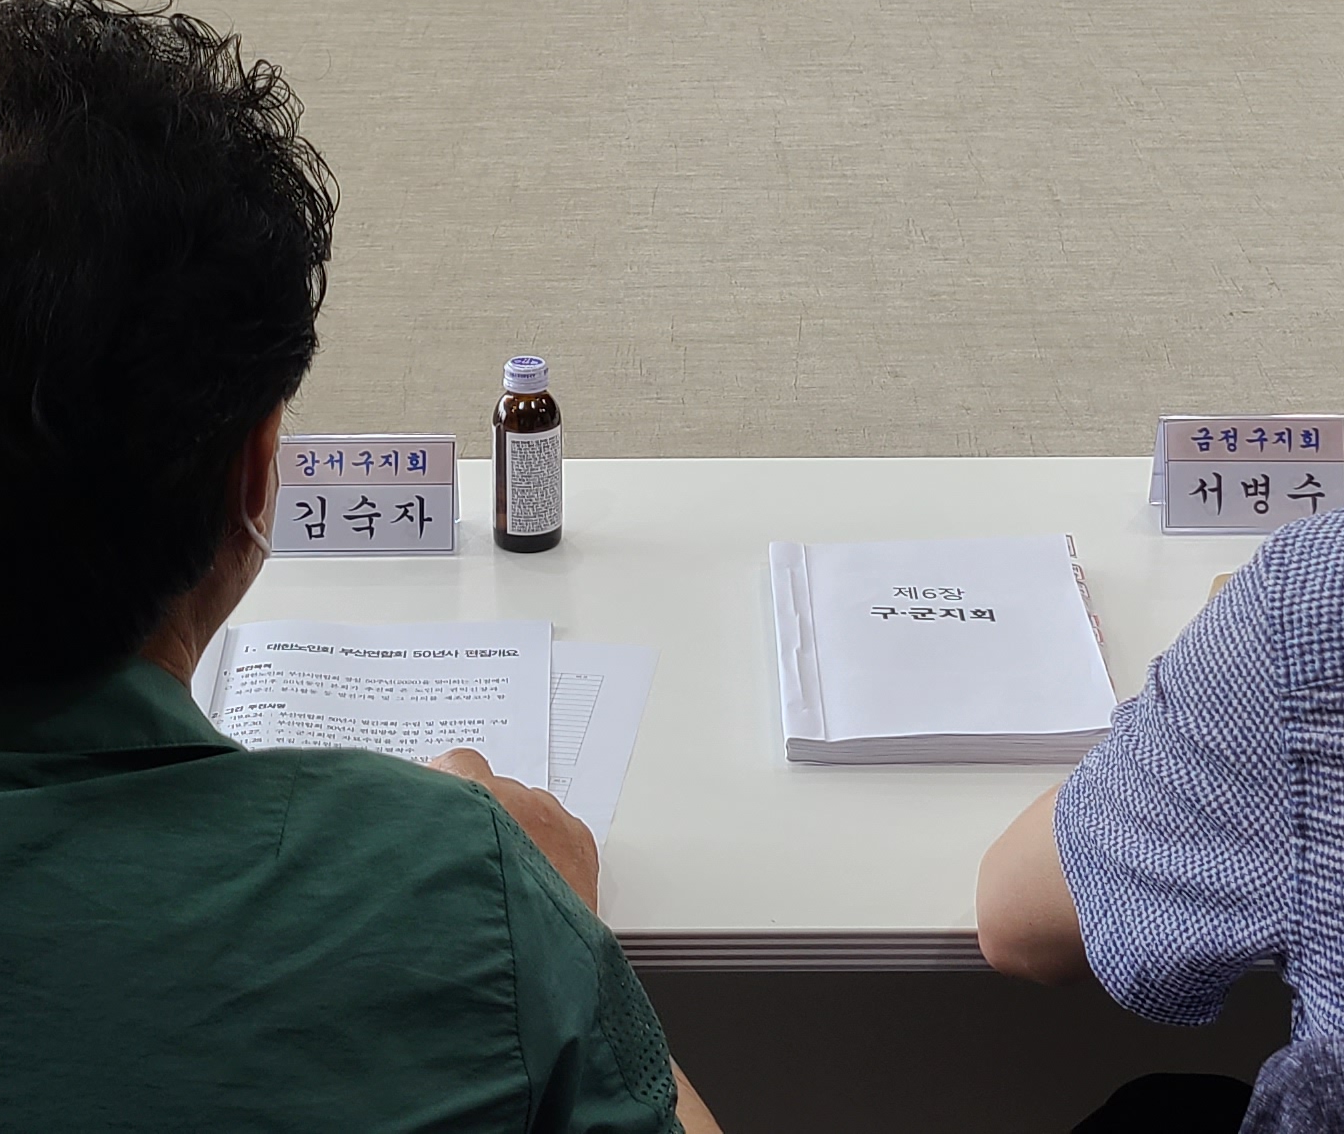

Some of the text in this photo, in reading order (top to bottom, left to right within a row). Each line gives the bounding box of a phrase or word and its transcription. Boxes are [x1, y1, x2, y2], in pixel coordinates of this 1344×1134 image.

[1190, 426, 1321, 453] 금정구지회
[295, 449, 428, 477] 강서구지회
[1188, 471, 1326, 516] 서병수
[292, 494, 433, 541] 김숙자
[893, 585, 966, 601] 제6장
[266, 643, 335, 654] 대한노인회
[338, 648, 408, 659] 부산연합회
[412, 649, 459, 659] 50년사
[464, 649, 520, 659] 편집개요
